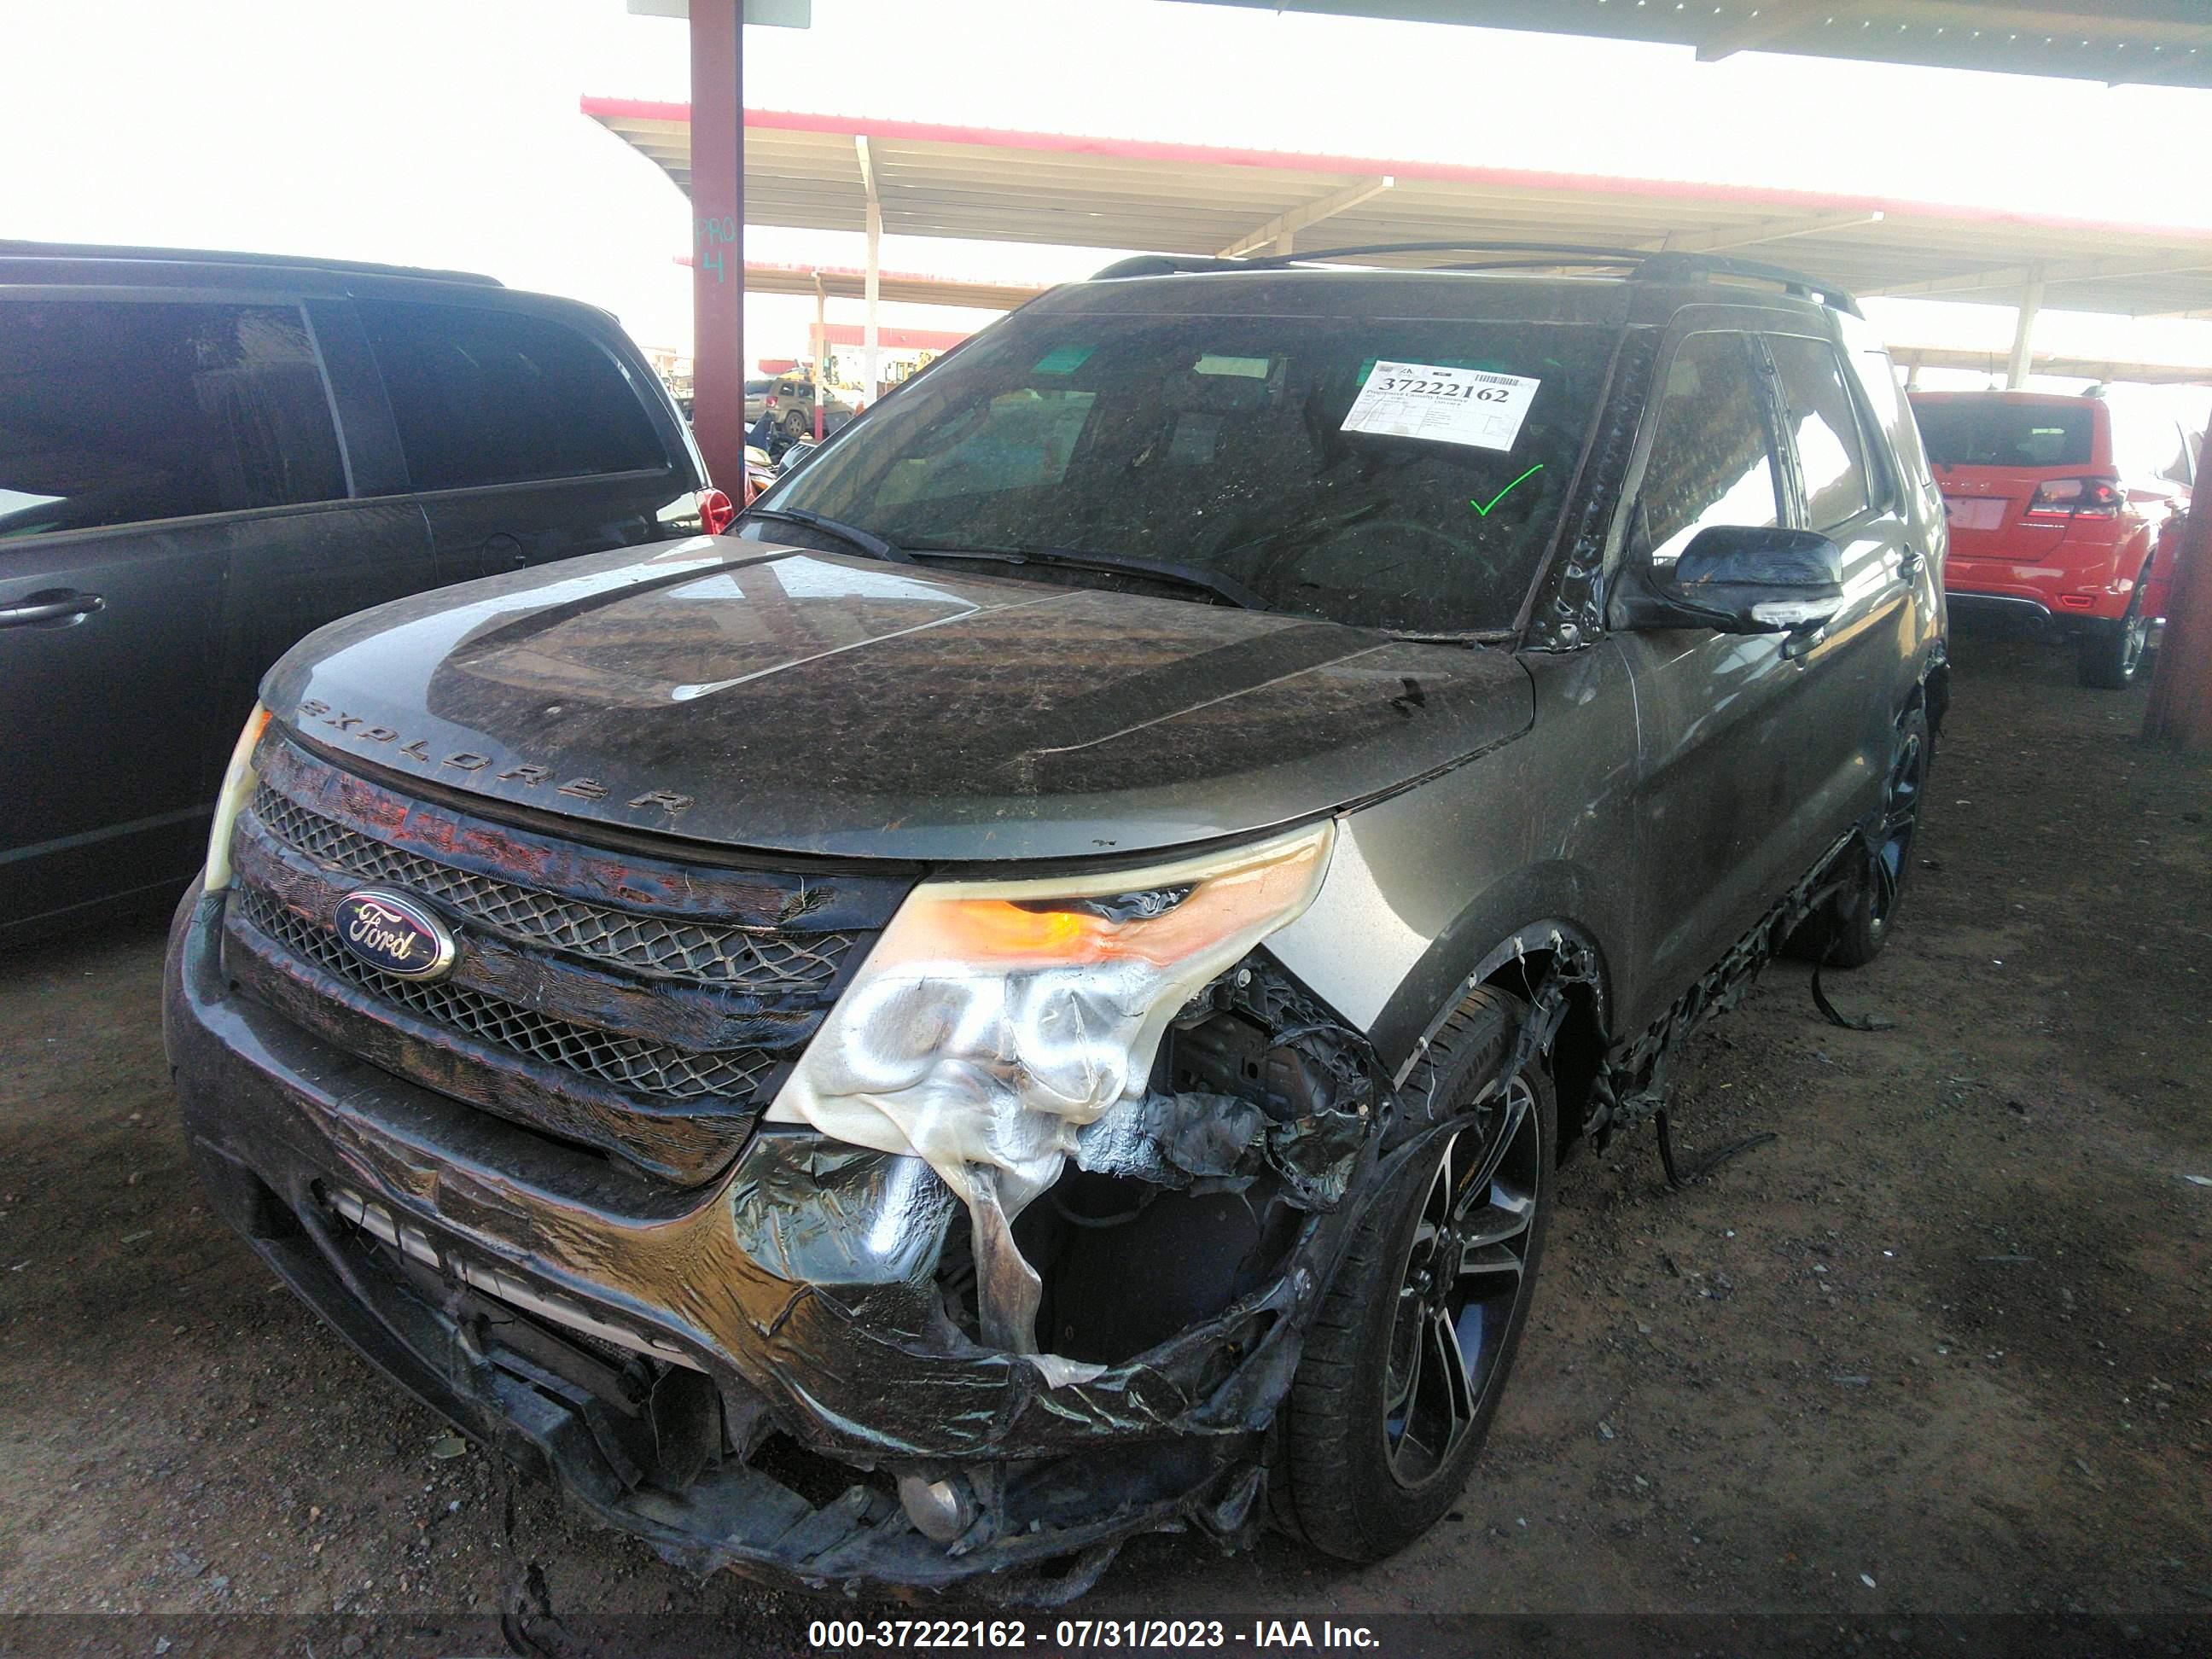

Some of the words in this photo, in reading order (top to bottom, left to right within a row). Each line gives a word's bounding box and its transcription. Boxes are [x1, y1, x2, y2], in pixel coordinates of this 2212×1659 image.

[702, 251, 724, 283] 4
[1378, 378, 1510, 403] 37222162
[294, 697, 696, 814] EXPLORER
[349, 902, 417, 961] Ford
